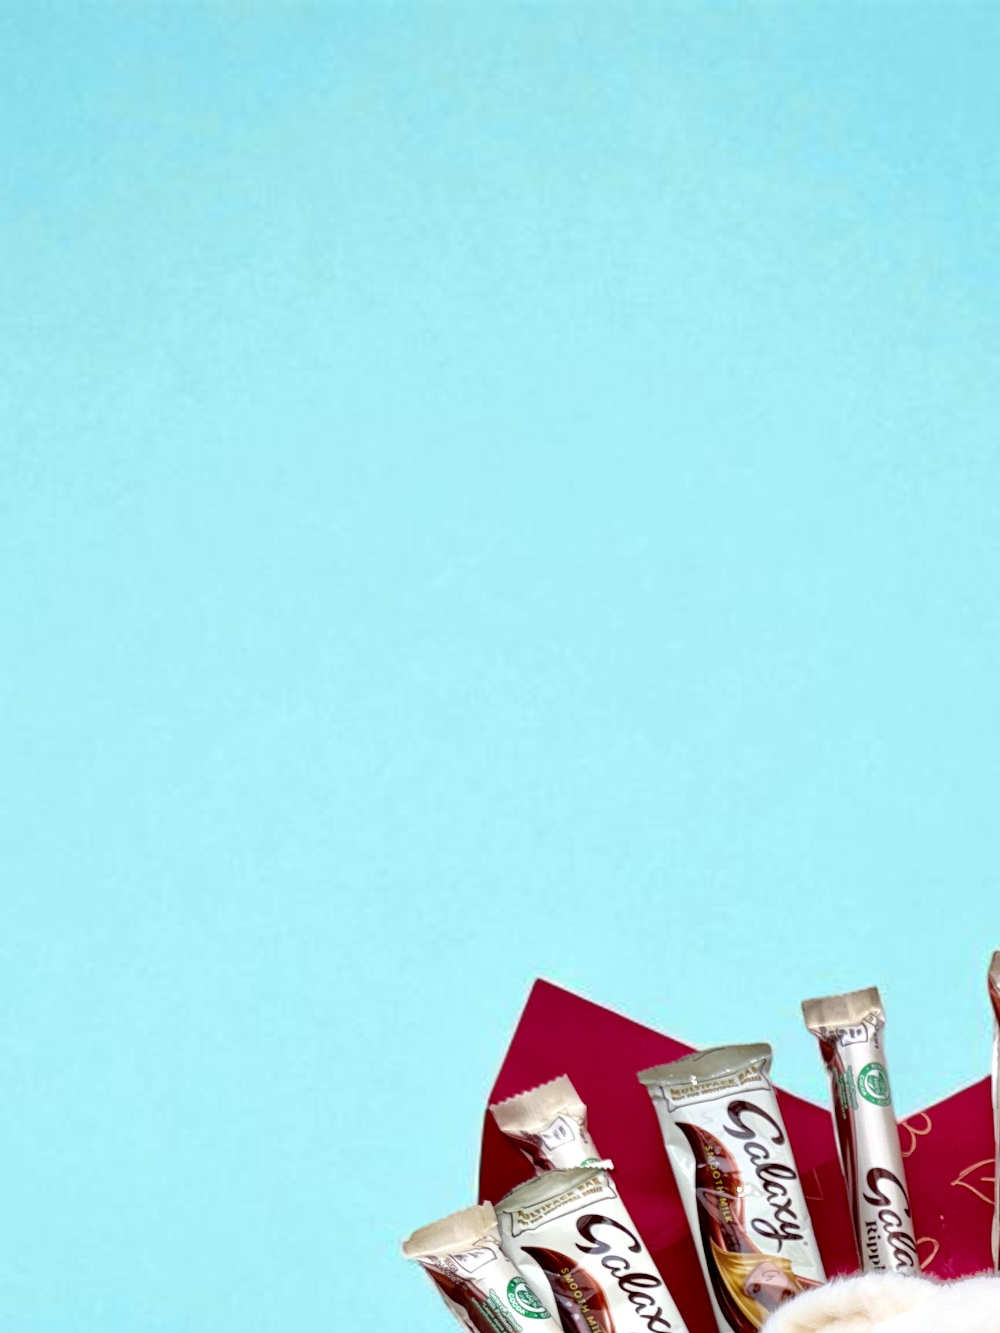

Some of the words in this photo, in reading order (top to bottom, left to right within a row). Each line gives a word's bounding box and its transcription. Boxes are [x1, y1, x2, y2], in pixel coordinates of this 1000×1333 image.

[704, 1145, 724, 1195] SMOOTH
[719, 1197, 733, 1223] MILK
[723, 1100, 803, 1253] Galaxy
[862, 1167, 918, 1272] Gala
[865, 1221, 882, 1270] Ripp
[561, 1267, 590, 1313] SMOOTH
